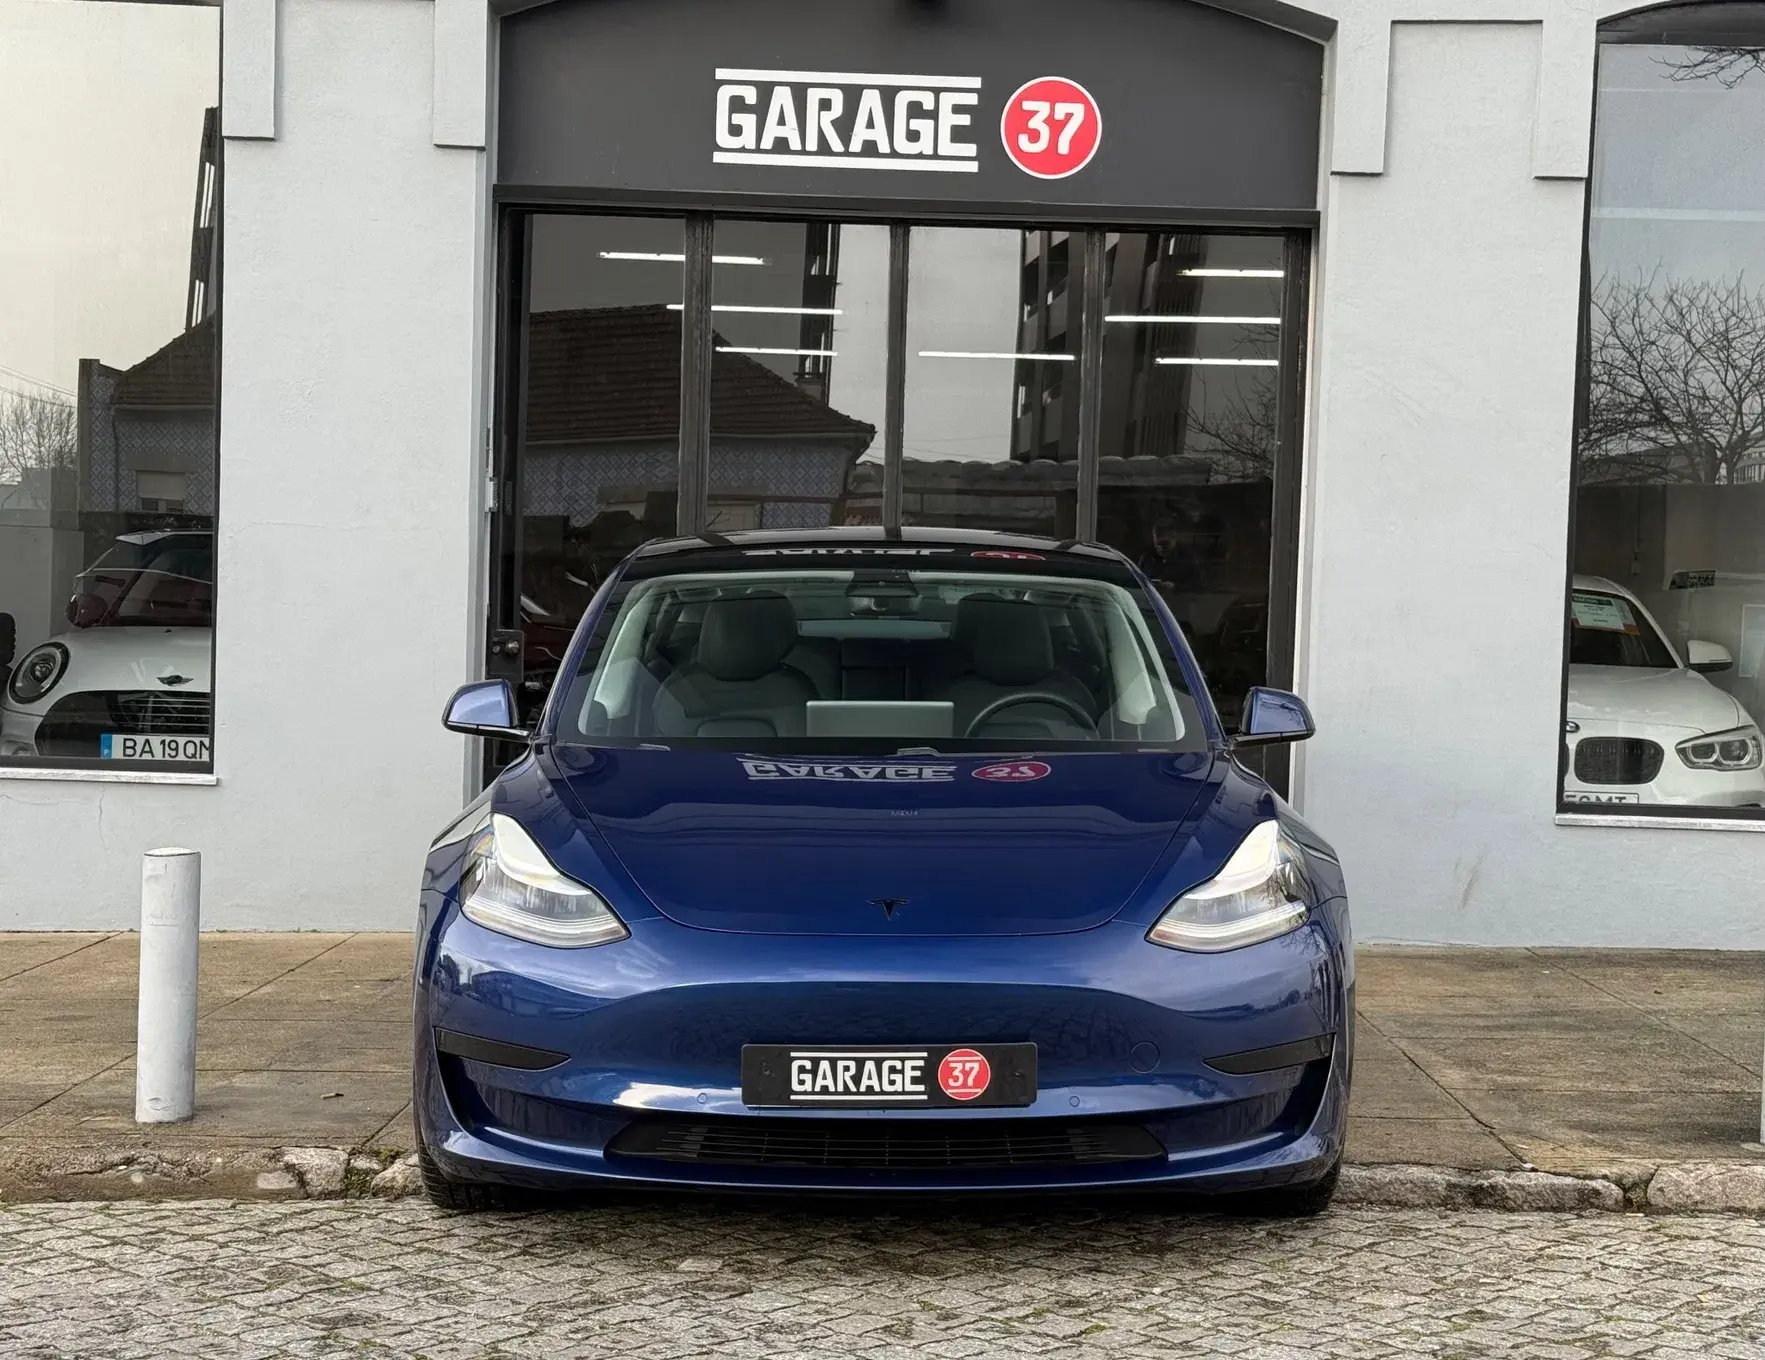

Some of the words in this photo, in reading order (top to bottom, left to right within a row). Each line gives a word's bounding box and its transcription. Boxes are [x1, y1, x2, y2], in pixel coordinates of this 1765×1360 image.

[715, 84, 979, 157] GARAGE
[1017, 100, 1085, 155] 37
[122, 738, 155, 758] BA
[160, 739, 179, 759] 19
[790, 1059, 926, 1092] GARAGE
[947, 1062, 980, 1087] 37
